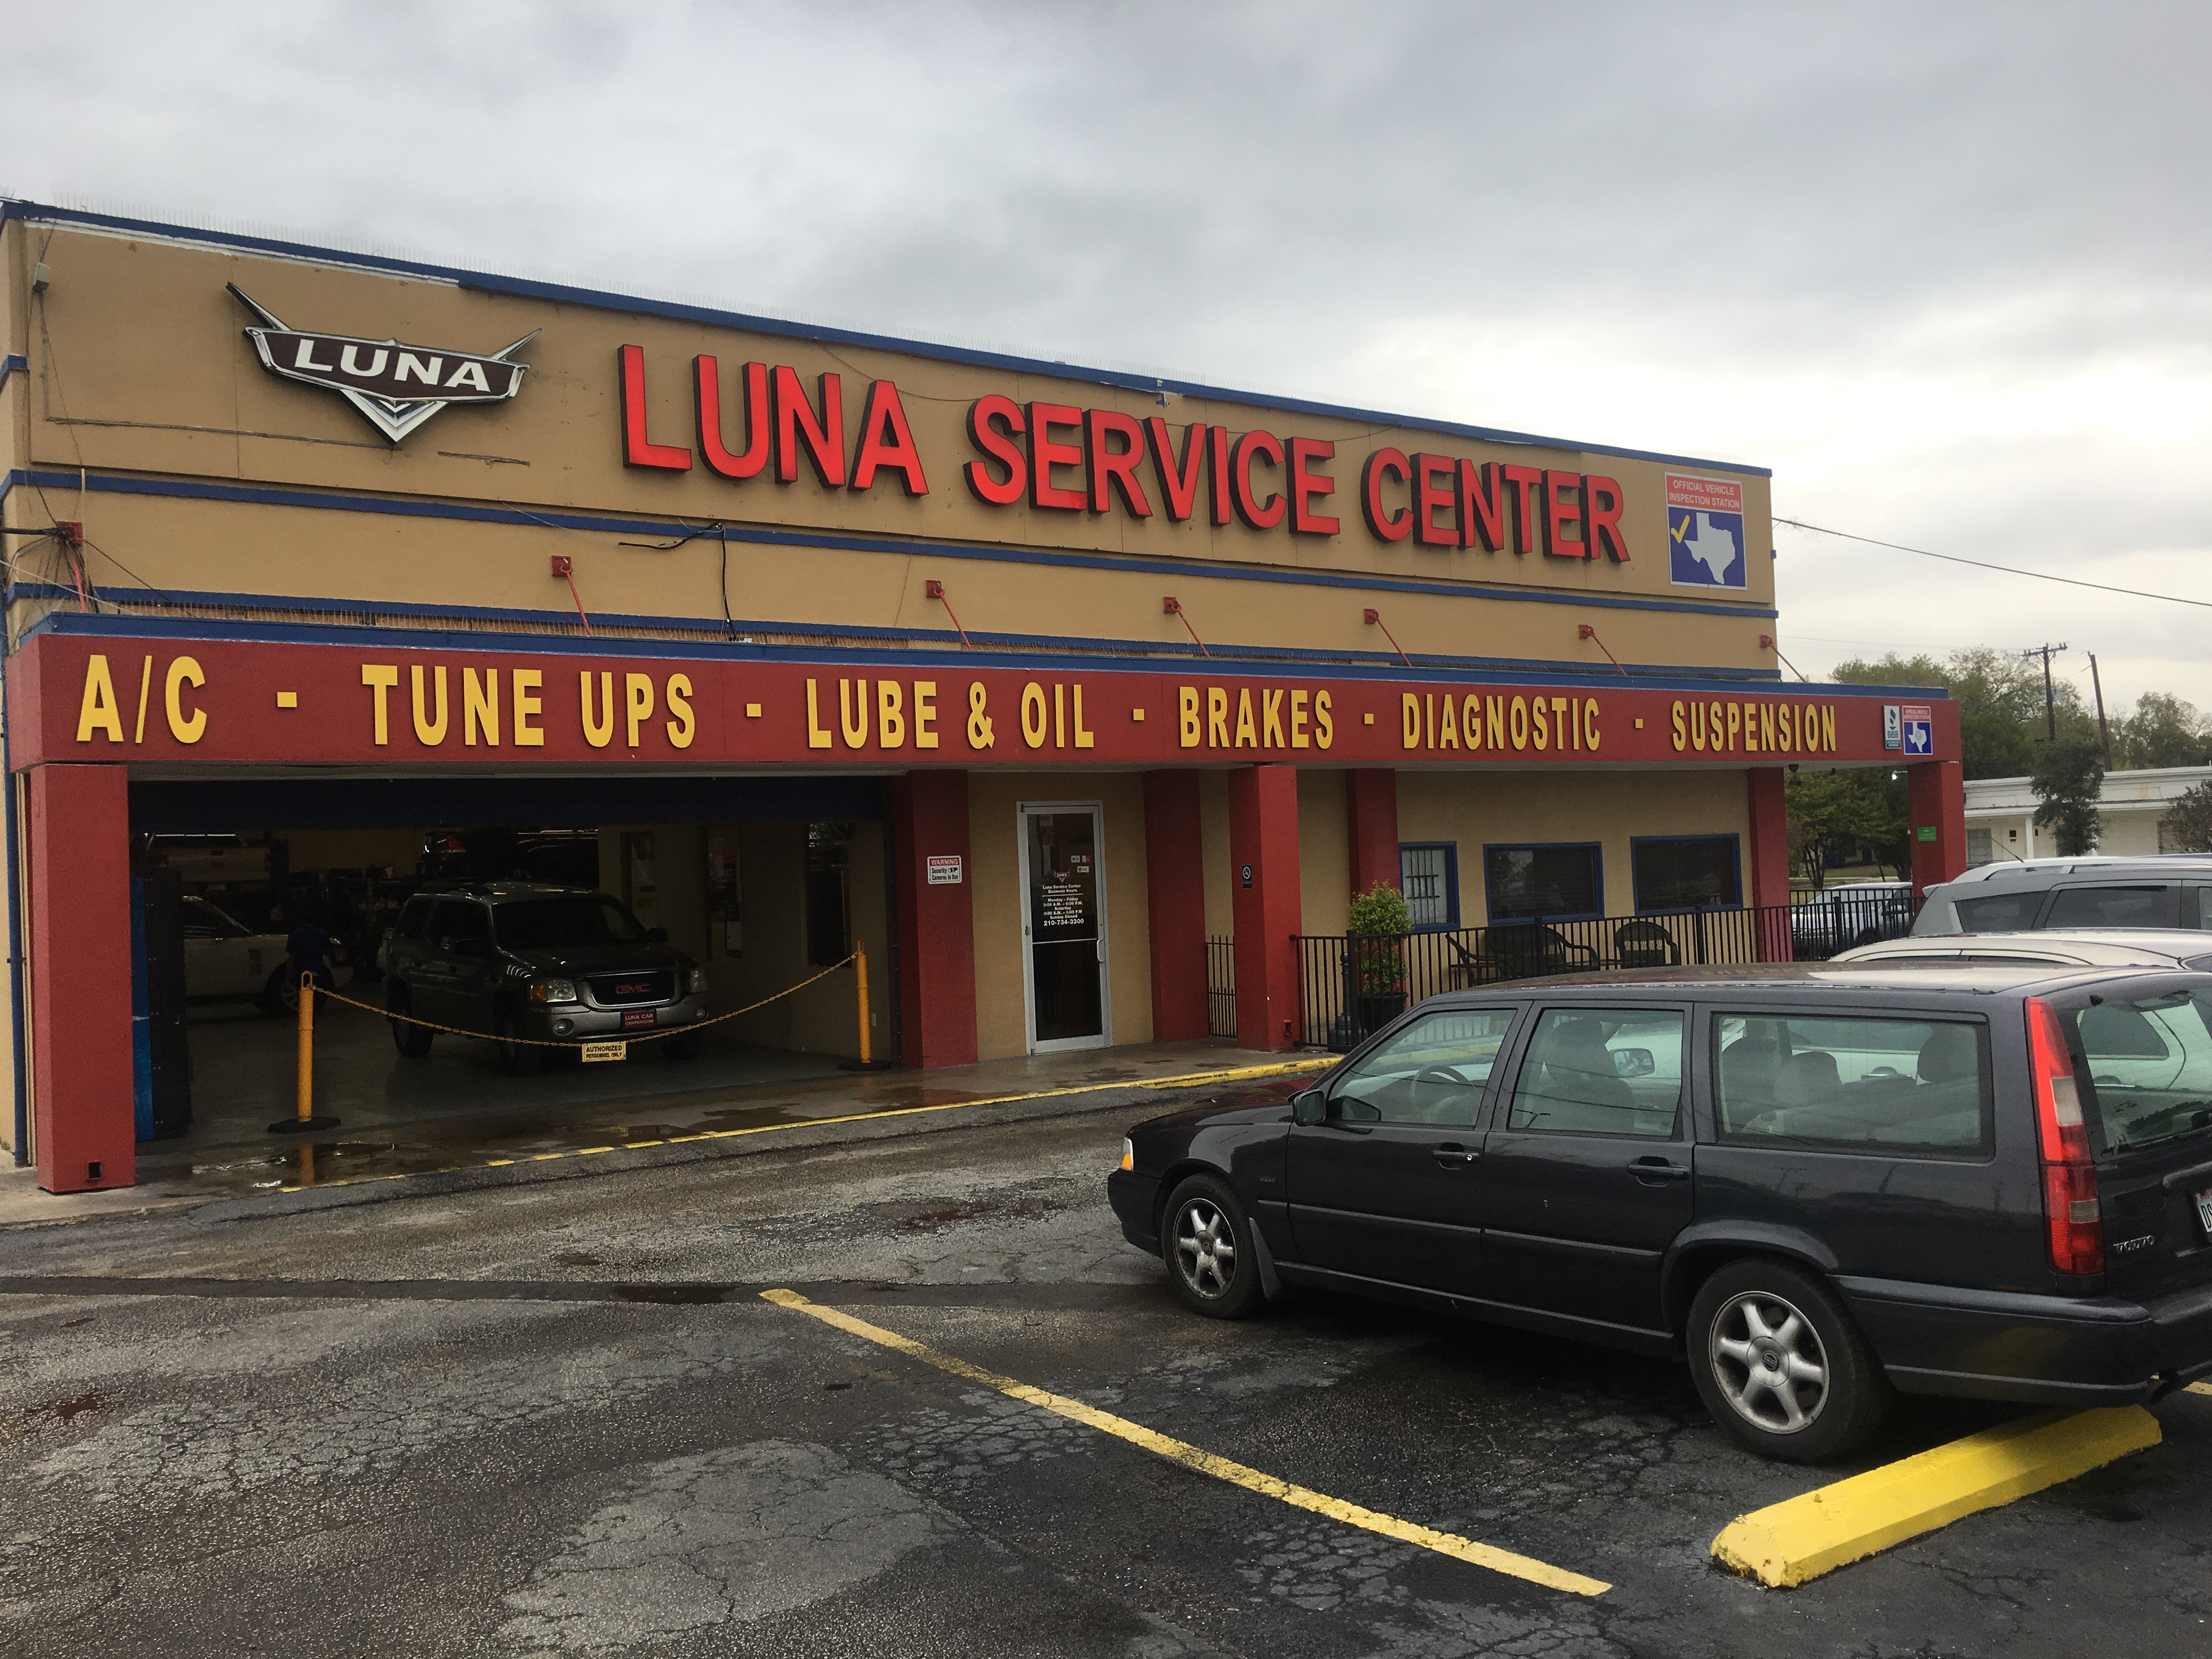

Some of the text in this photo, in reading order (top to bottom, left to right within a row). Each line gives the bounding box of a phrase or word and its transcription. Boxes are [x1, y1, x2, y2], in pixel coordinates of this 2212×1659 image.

[295, 338, 491, 393] LUNA
[617, 344, 1631, 562] LUNA SERVICE CENTER
[1673, 479, 1735, 496] OFFICIAL VEHICLE
[1669, 492, 1740, 509] INSPECTION STATION
[76, 654, 207, 743] A/C
[362, 664, 544, 746] TUNE
[580, 670, 695, 748] UPS
[806, 678, 939, 748] LUBE
[968, 681, 995, 749] &
[1021, 682, 1094, 748] OIL
[1179, 686, 1334, 750] BRAKES
[1402, 692, 1601, 751] DIAGNOSTIC
[1672, 700, 1837, 752] SUSPENSION
[1887, 730, 1899, 738] BBB
[616, 984, 651, 994] GMC
[2113, 1235, 2155, 1251] VOLVO
